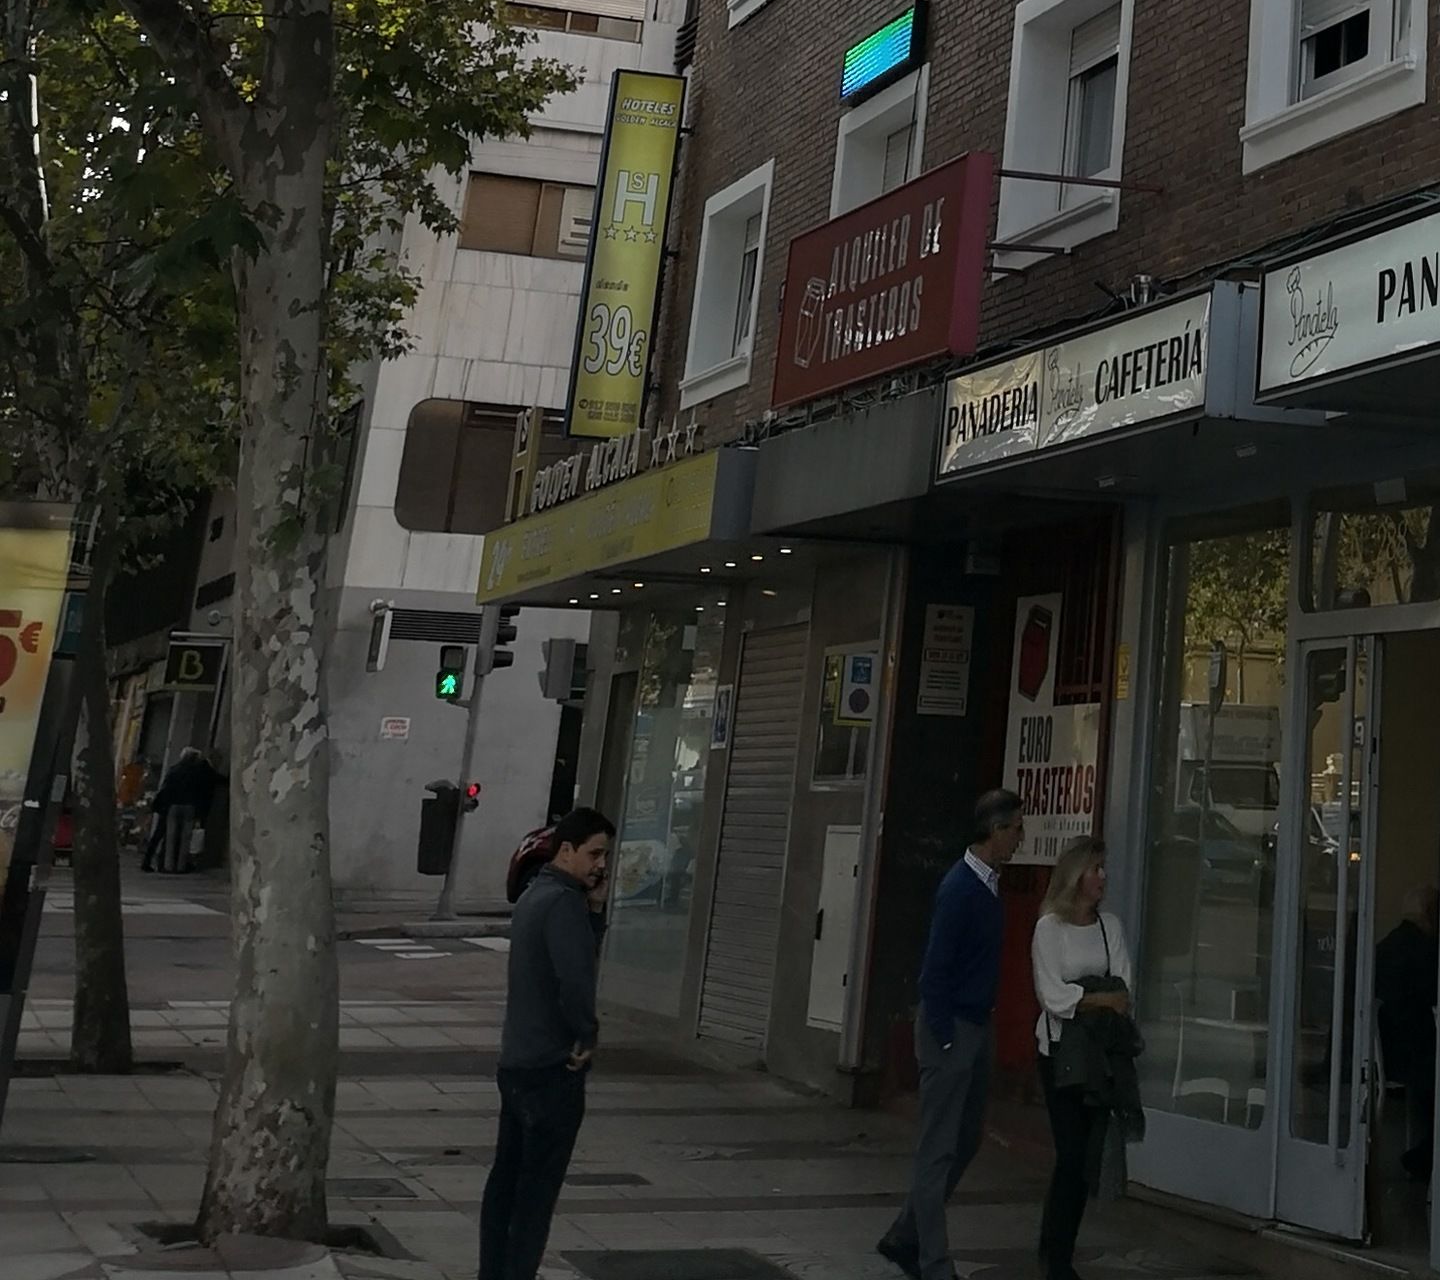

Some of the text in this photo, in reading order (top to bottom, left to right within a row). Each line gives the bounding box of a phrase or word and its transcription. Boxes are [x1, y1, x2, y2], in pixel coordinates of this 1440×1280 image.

[622, 98, 676, 116] HOTELES
[828, 197, 945, 299] ALQUILER DE
[583, 303, 646, 377] 39€
[820, 275, 923, 364] TRASTEROS
[1288, 281, 1339, 345] Panatela
[1094, 320, 1202, 405] CAFETERÍA
[946, 373, 1038, 446] PANADERÍA
[530, 428, 641, 513] GOLDEN ALCALA
[1019, 715, 1053, 763] EURO
[1017, 765, 1094, 816] TRASTEROS
